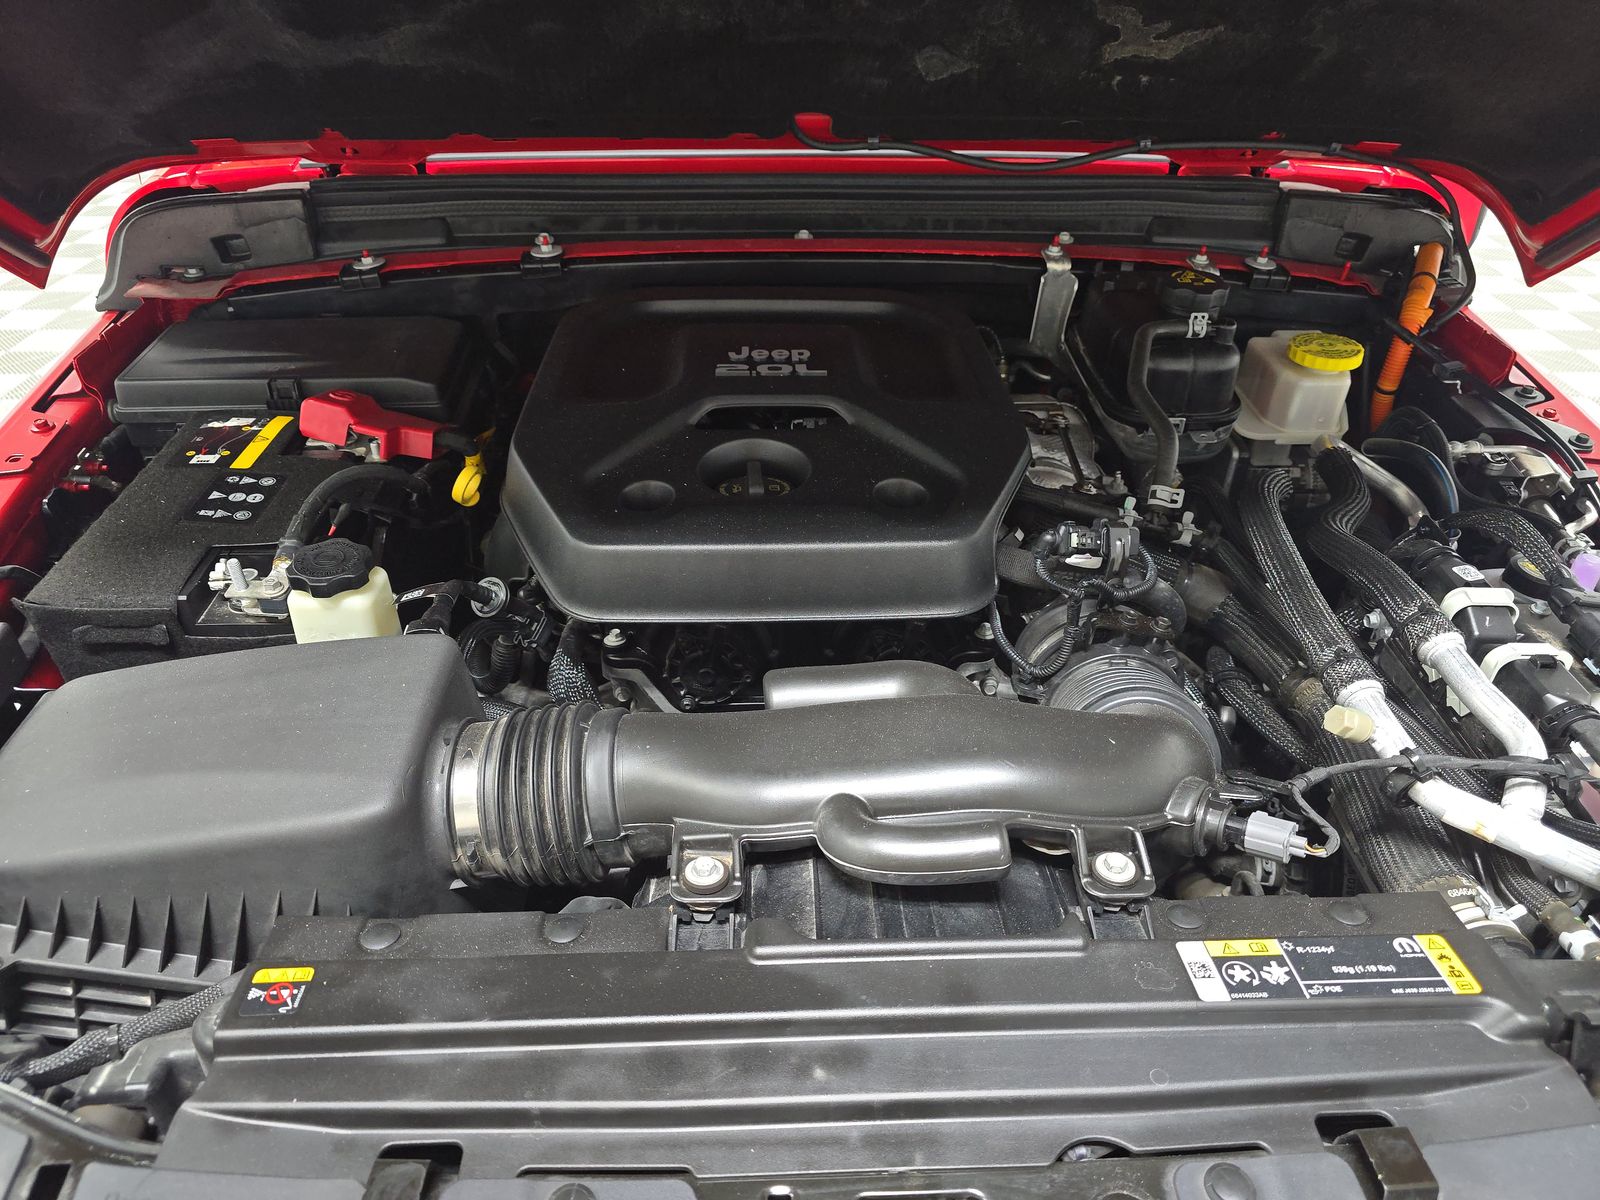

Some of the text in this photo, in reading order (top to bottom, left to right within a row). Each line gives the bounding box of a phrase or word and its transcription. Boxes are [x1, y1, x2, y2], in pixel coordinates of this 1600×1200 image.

[727, 346, 811, 362] Jeep
[715, 363, 828, 377] 2.0L
[1296, 945, 1335, 954] R-1234yf
